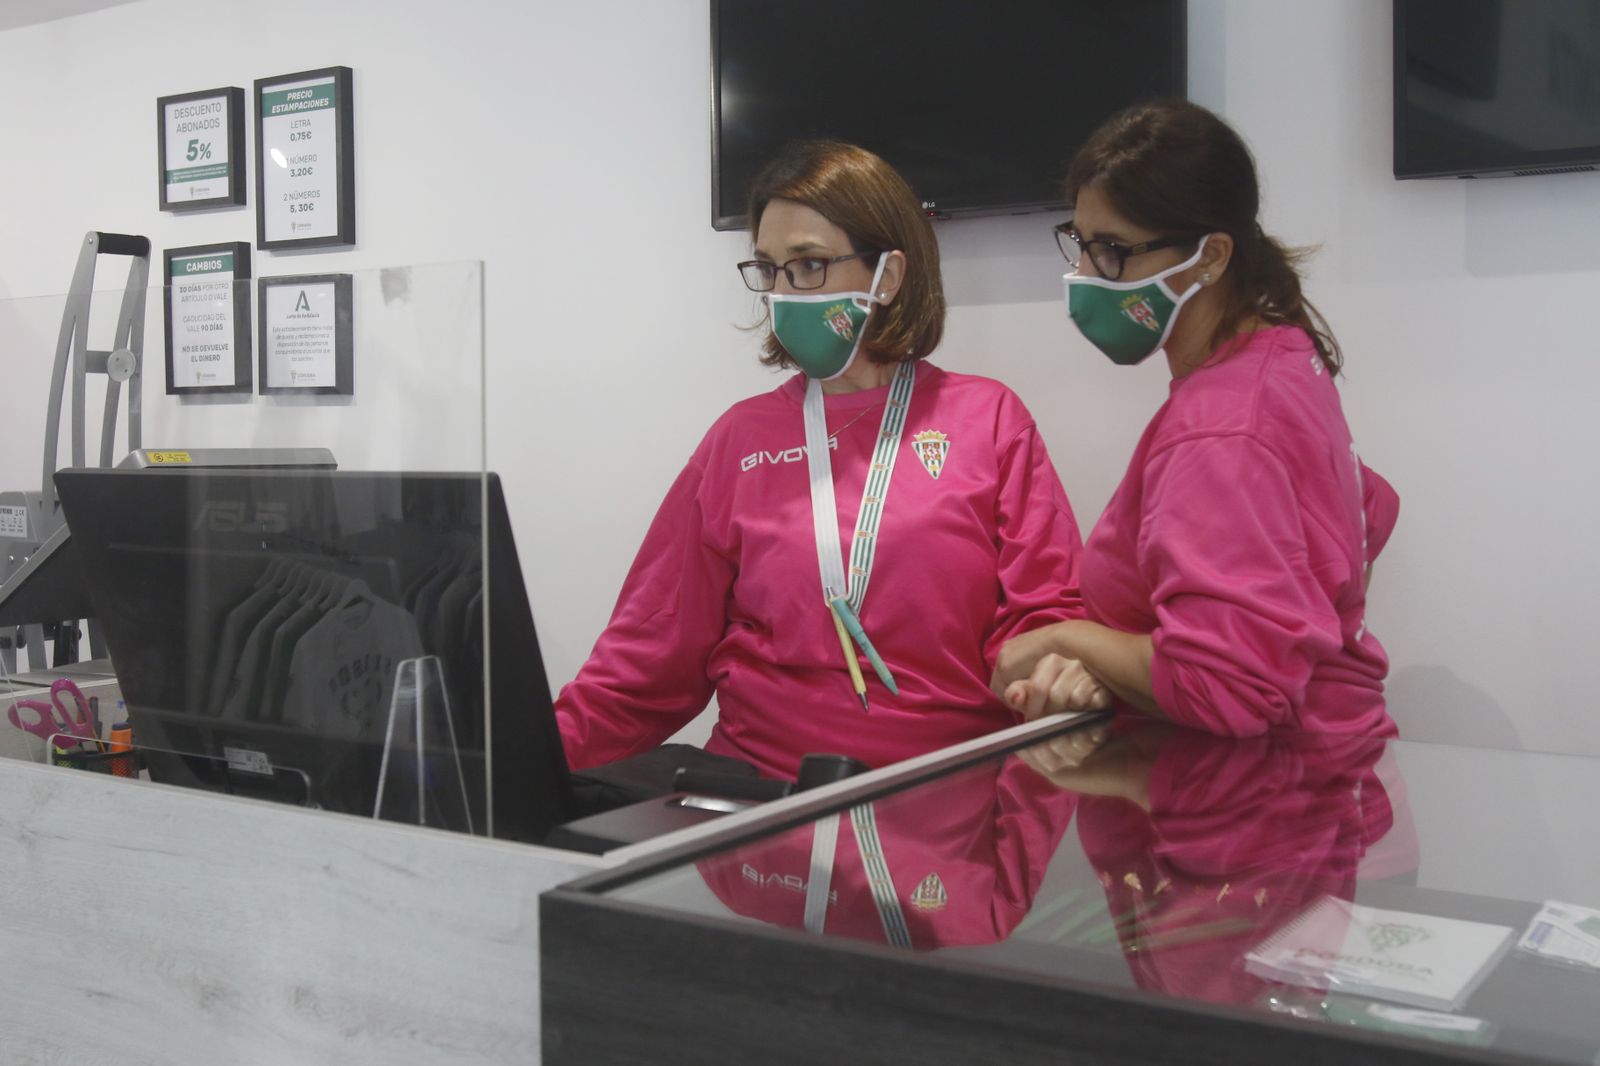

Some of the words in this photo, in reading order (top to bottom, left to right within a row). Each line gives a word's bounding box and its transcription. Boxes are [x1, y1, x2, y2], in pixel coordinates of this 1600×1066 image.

[287, 89, 313, 101] PRECIO
[174, 102, 222, 119] DESCUENTO
[271, 98, 329, 113] ESTAMPACIONES
[176, 117, 221, 133] ABONADOS
[290, 119, 312, 129] LETRA
[289, 131, 312, 142] 0,75€
[186, 138, 212, 162] 5%
[290, 167, 313, 178] 3,20€
[186, 259, 222, 273] CAMBIOS
[210, 322, 223, 331] DÍAS
[200, 343, 229, 352] DEVUELVE
[199, 353, 221, 362] DINERO
[740, 436, 839, 473] GIVOA
